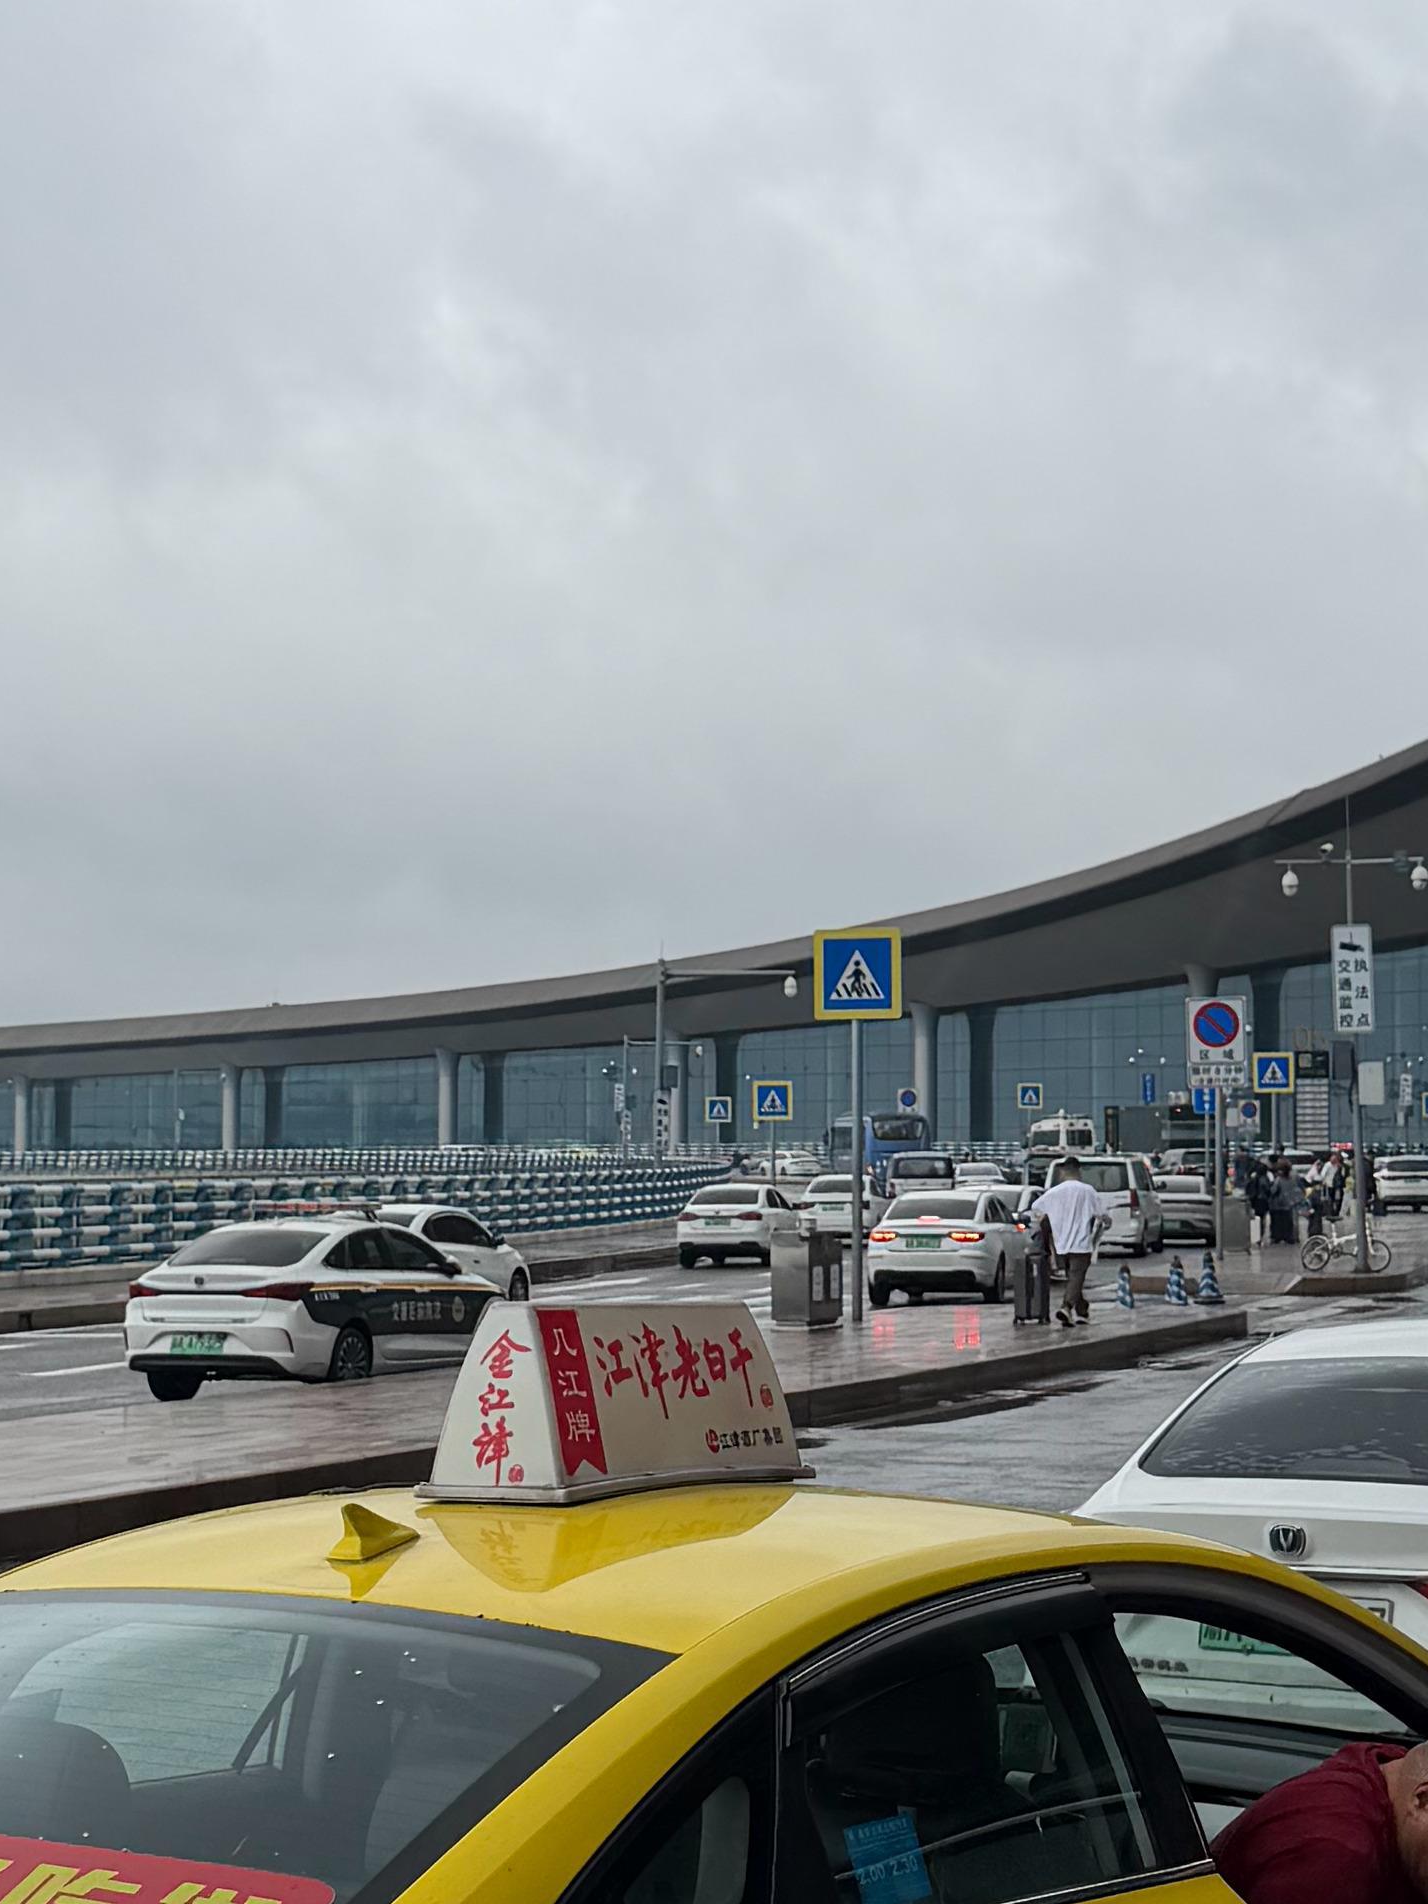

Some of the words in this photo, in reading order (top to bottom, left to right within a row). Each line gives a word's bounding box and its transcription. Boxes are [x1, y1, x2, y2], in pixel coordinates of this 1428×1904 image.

[1354, 958, 1370, 1027] 执法点
[472, 1328, 532, 1488] 金江津
[551, 1327, 596, 1443] 几江牌
[593, 1321, 754, 1420] 江津老白干
